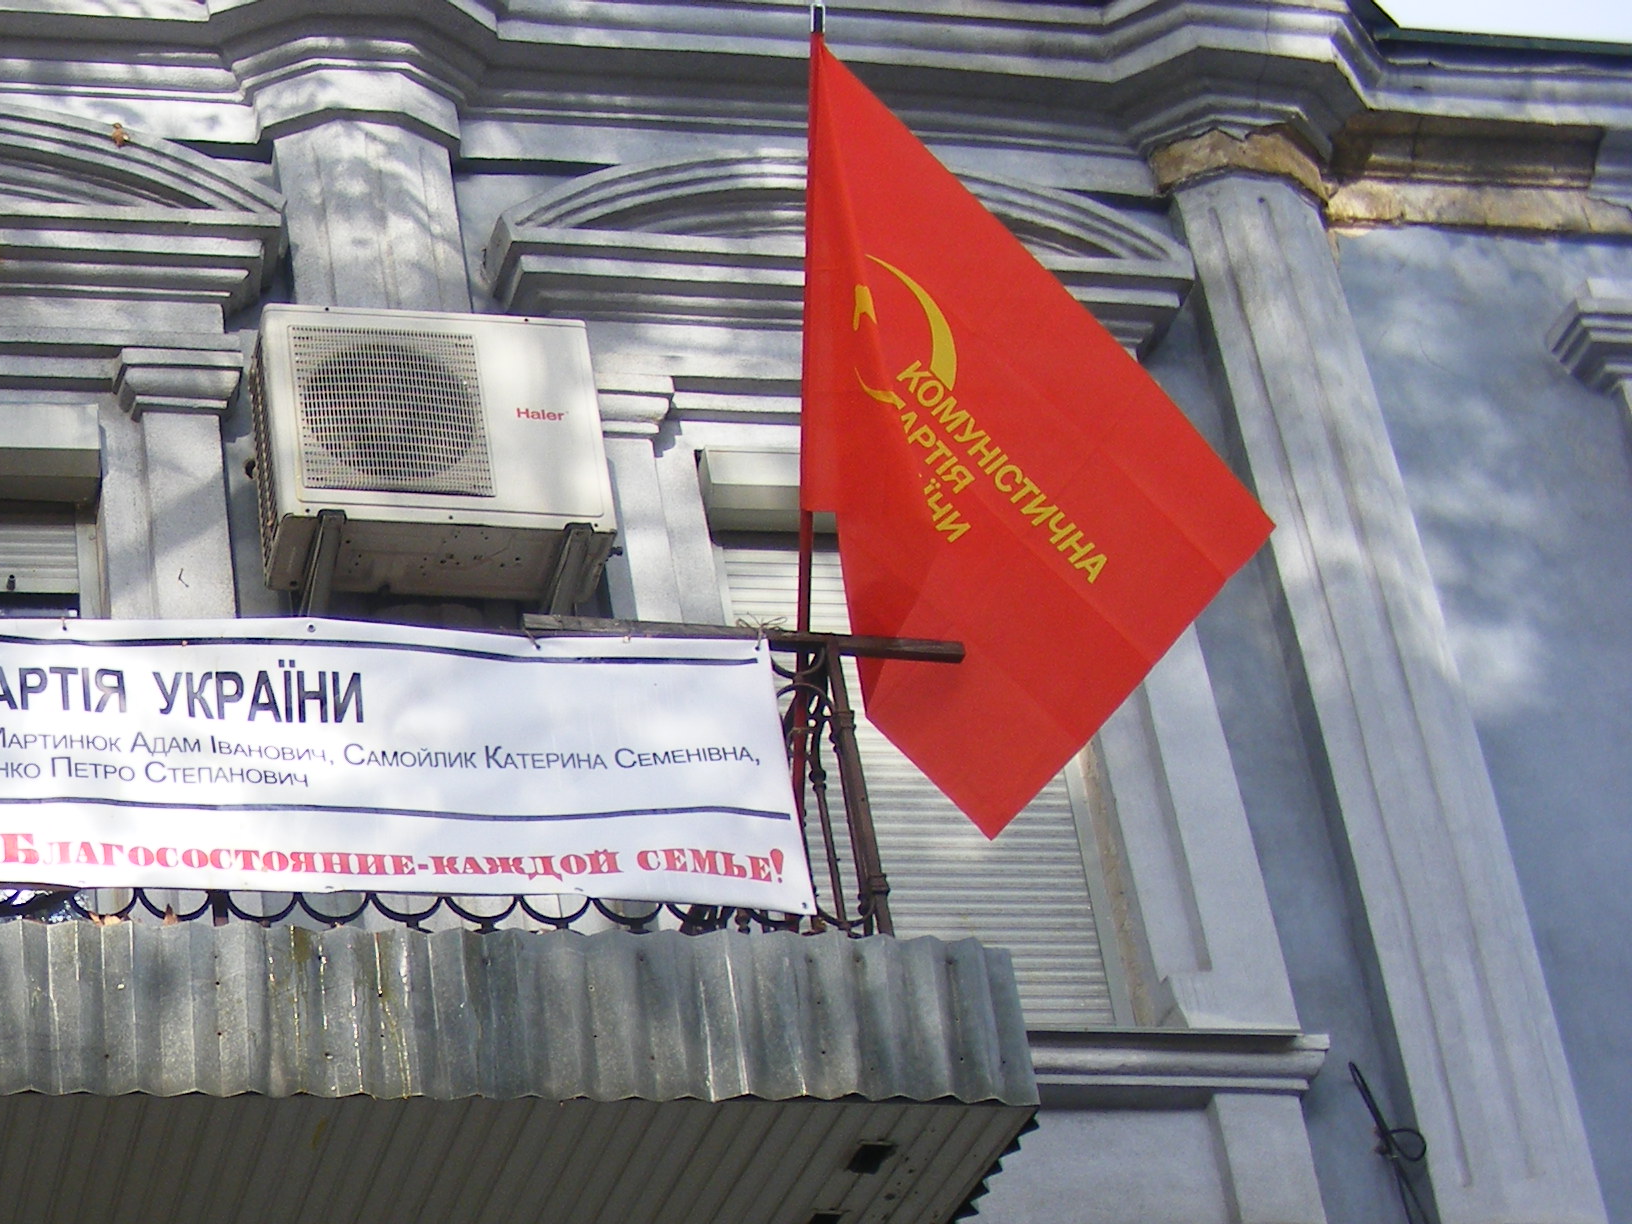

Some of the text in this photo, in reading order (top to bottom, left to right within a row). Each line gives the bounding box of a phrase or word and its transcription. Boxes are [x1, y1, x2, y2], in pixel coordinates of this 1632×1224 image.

[516, 407, 566, 423] Haier
[896, 360, 1108, 584] КОМУНІСТИЧНА
[152, 659, 366, 724] УКРАЇНИ
